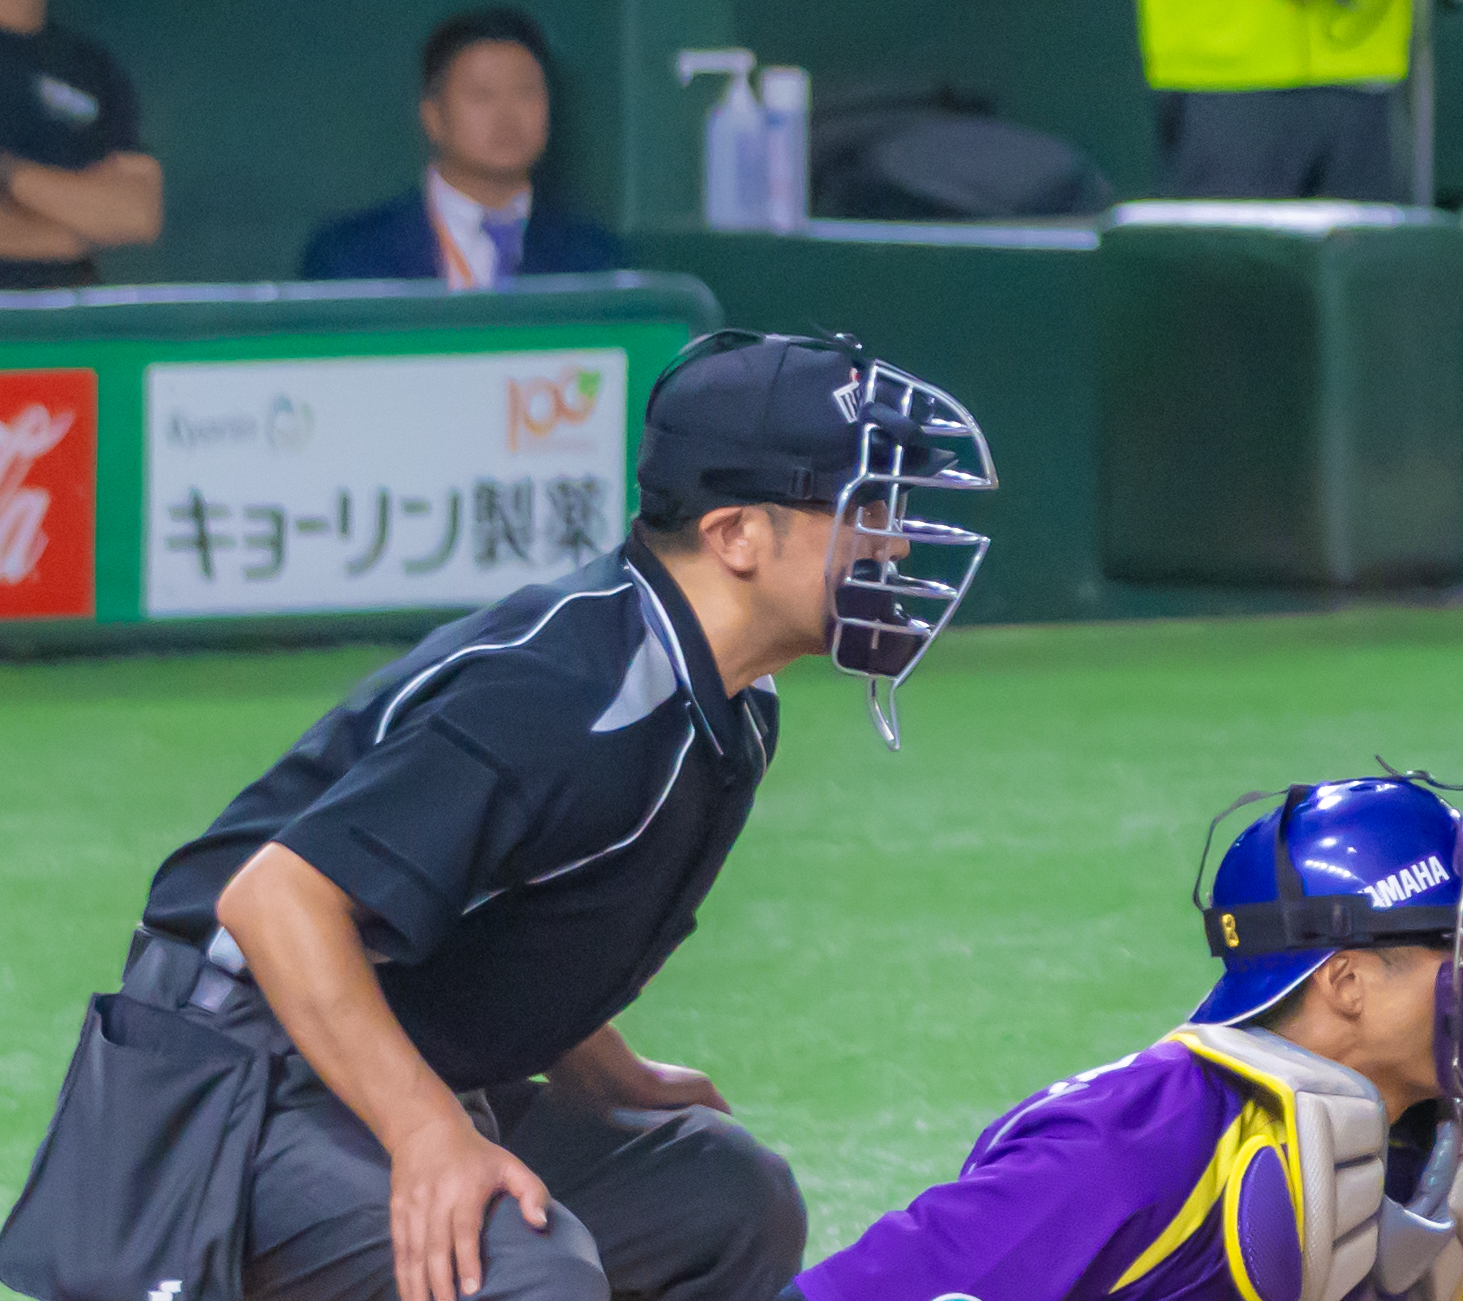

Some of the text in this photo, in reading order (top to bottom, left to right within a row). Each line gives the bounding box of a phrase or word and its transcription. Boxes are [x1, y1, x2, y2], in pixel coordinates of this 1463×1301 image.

[164, 474, 612, 581] キョーリン製薬
[1354, 854, 1451, 910] AMAHA
